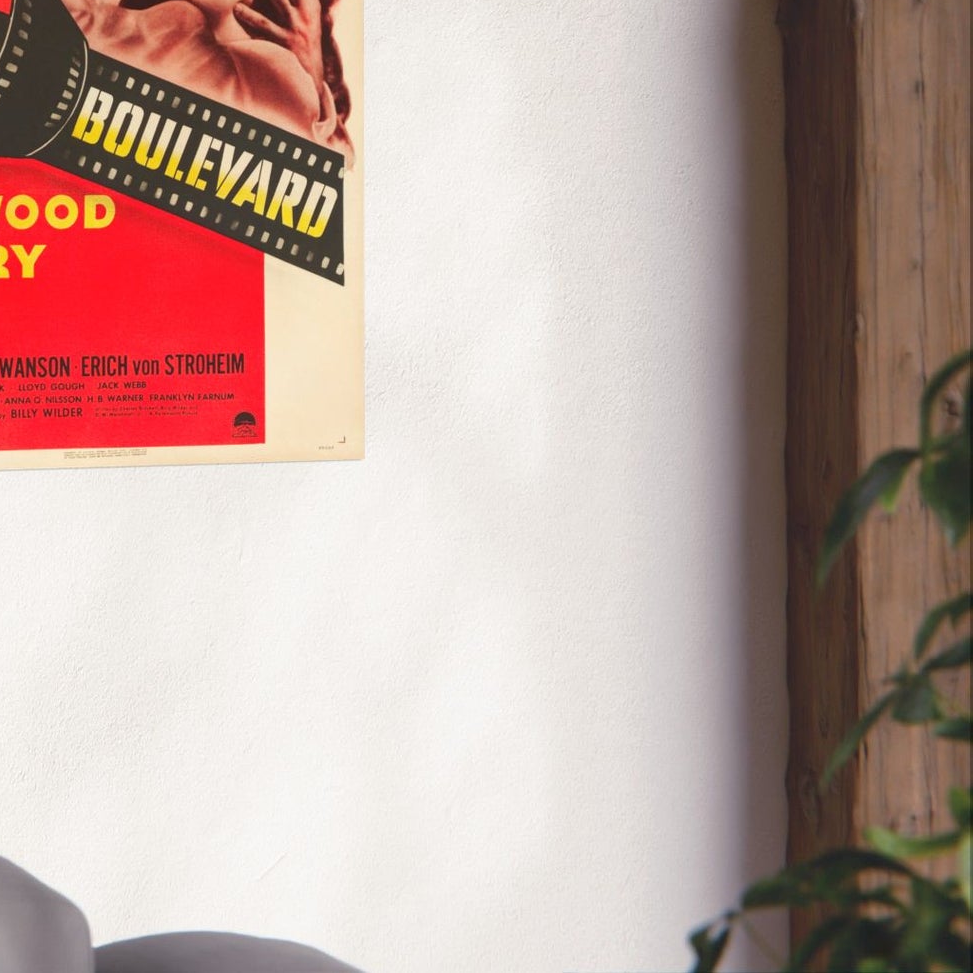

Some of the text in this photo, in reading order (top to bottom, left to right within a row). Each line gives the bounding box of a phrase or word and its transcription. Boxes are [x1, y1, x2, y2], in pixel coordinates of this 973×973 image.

[72, 86, 338, 239] BOULEVARD
[81, 355, 128, 377] ERICH
[133, 359, 159, 375] von
[165, 353, 245, 375] STROHEIM
[18, 383, 46, 391] LLOYD
[51, 382, 85, 391] GOUGH
[97, 381, 119, 389] JACK
[123, 381, 147, 389] WEBB
[4, 396, 31, 405] ANNA
[45, 395, 82, 404] NILSSON
[107, 393, 143, 402] WARNER
[149, 393, 195, 401] FRANKLYN
[197, 392, 234, 401] FARNUM
[10, 408, 37, 419] BILLY
[43, 407, 83, 418] WILDER
